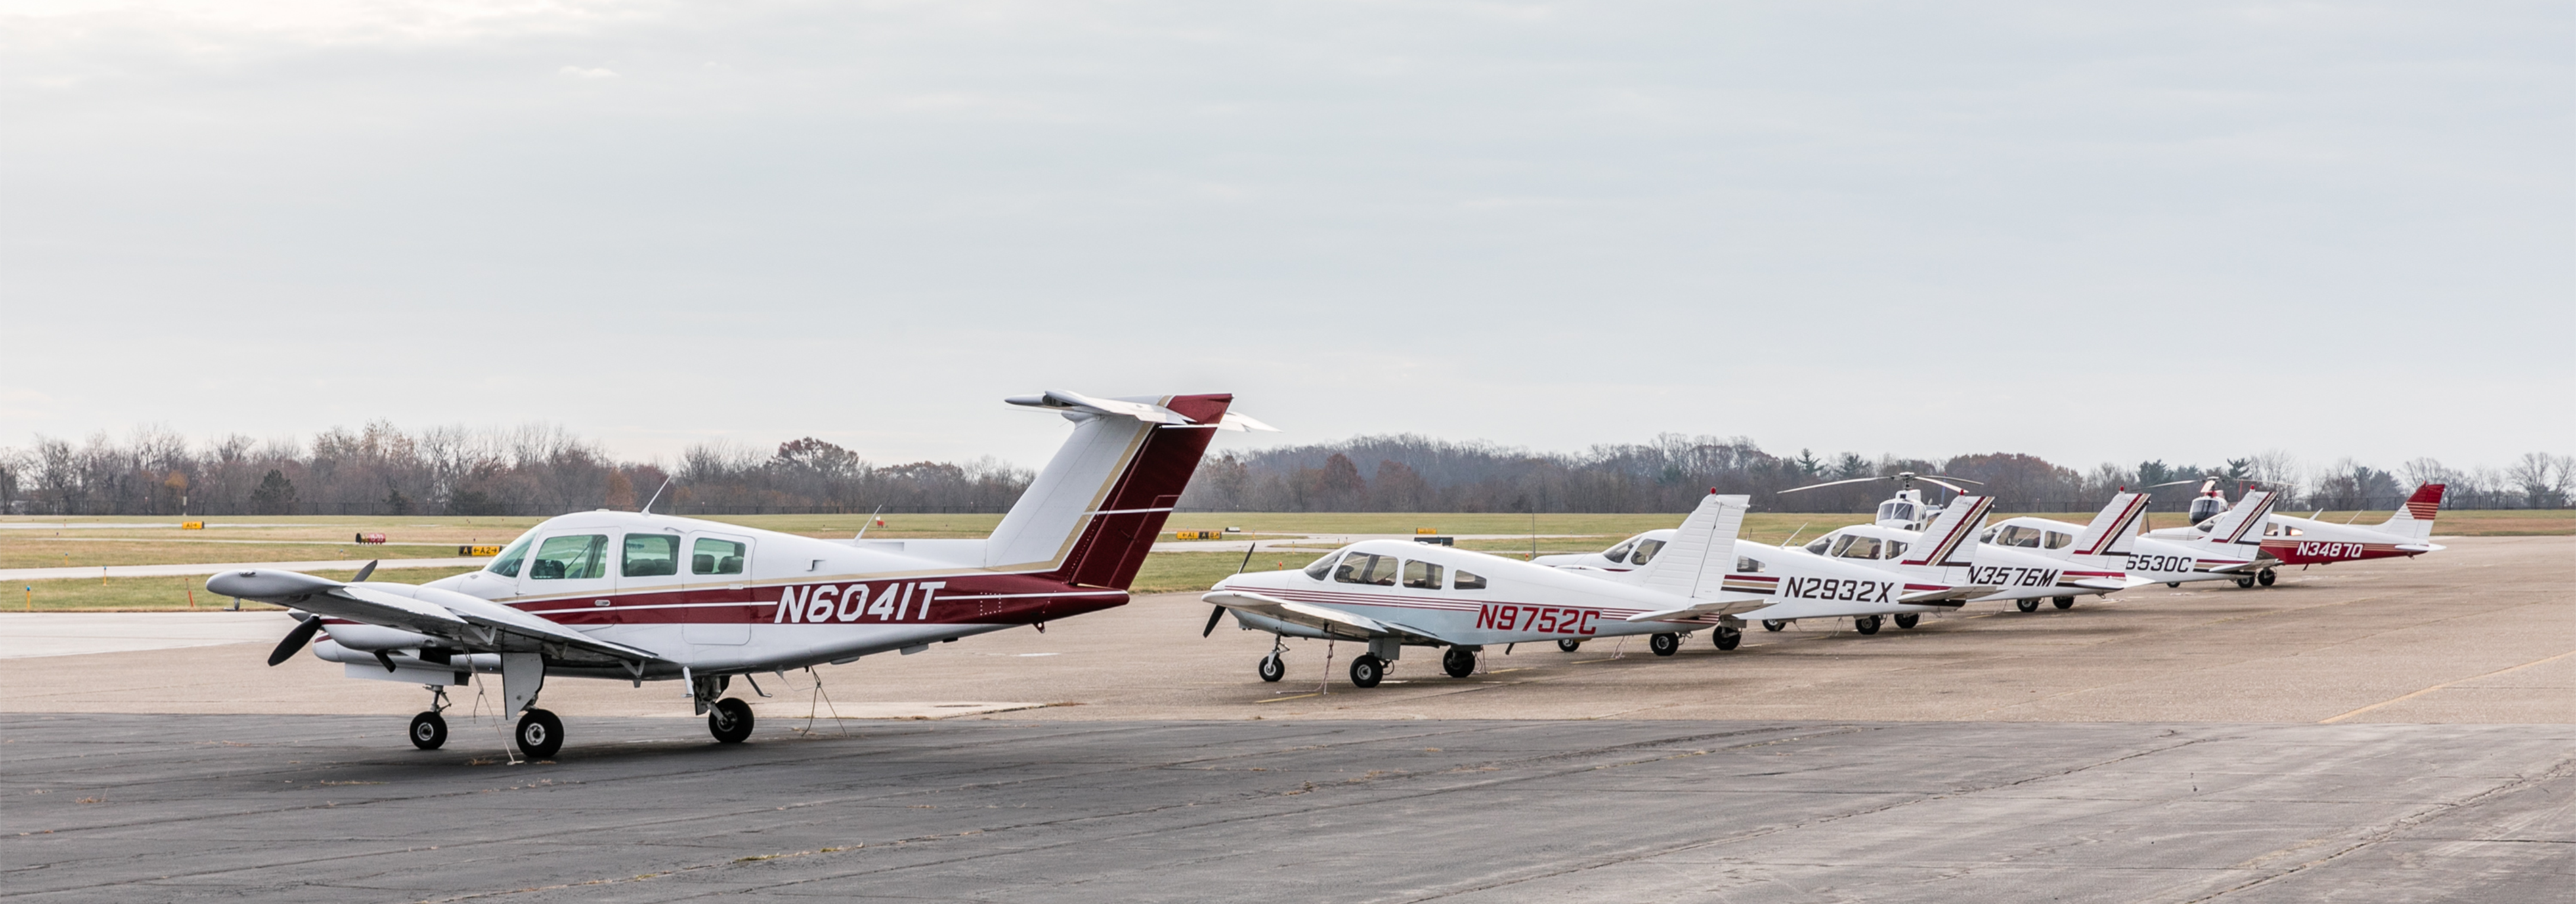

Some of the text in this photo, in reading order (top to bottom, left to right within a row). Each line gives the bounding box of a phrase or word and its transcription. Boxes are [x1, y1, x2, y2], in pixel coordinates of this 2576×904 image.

[463, 547, 468, 555] A
[1784, 576, 1895, 603] N2932X
[1967, 566, 2059, 587] N3576M
[774, 581, 947, 624] N6041T
[1476, 604, 1600, 635] N9752C
